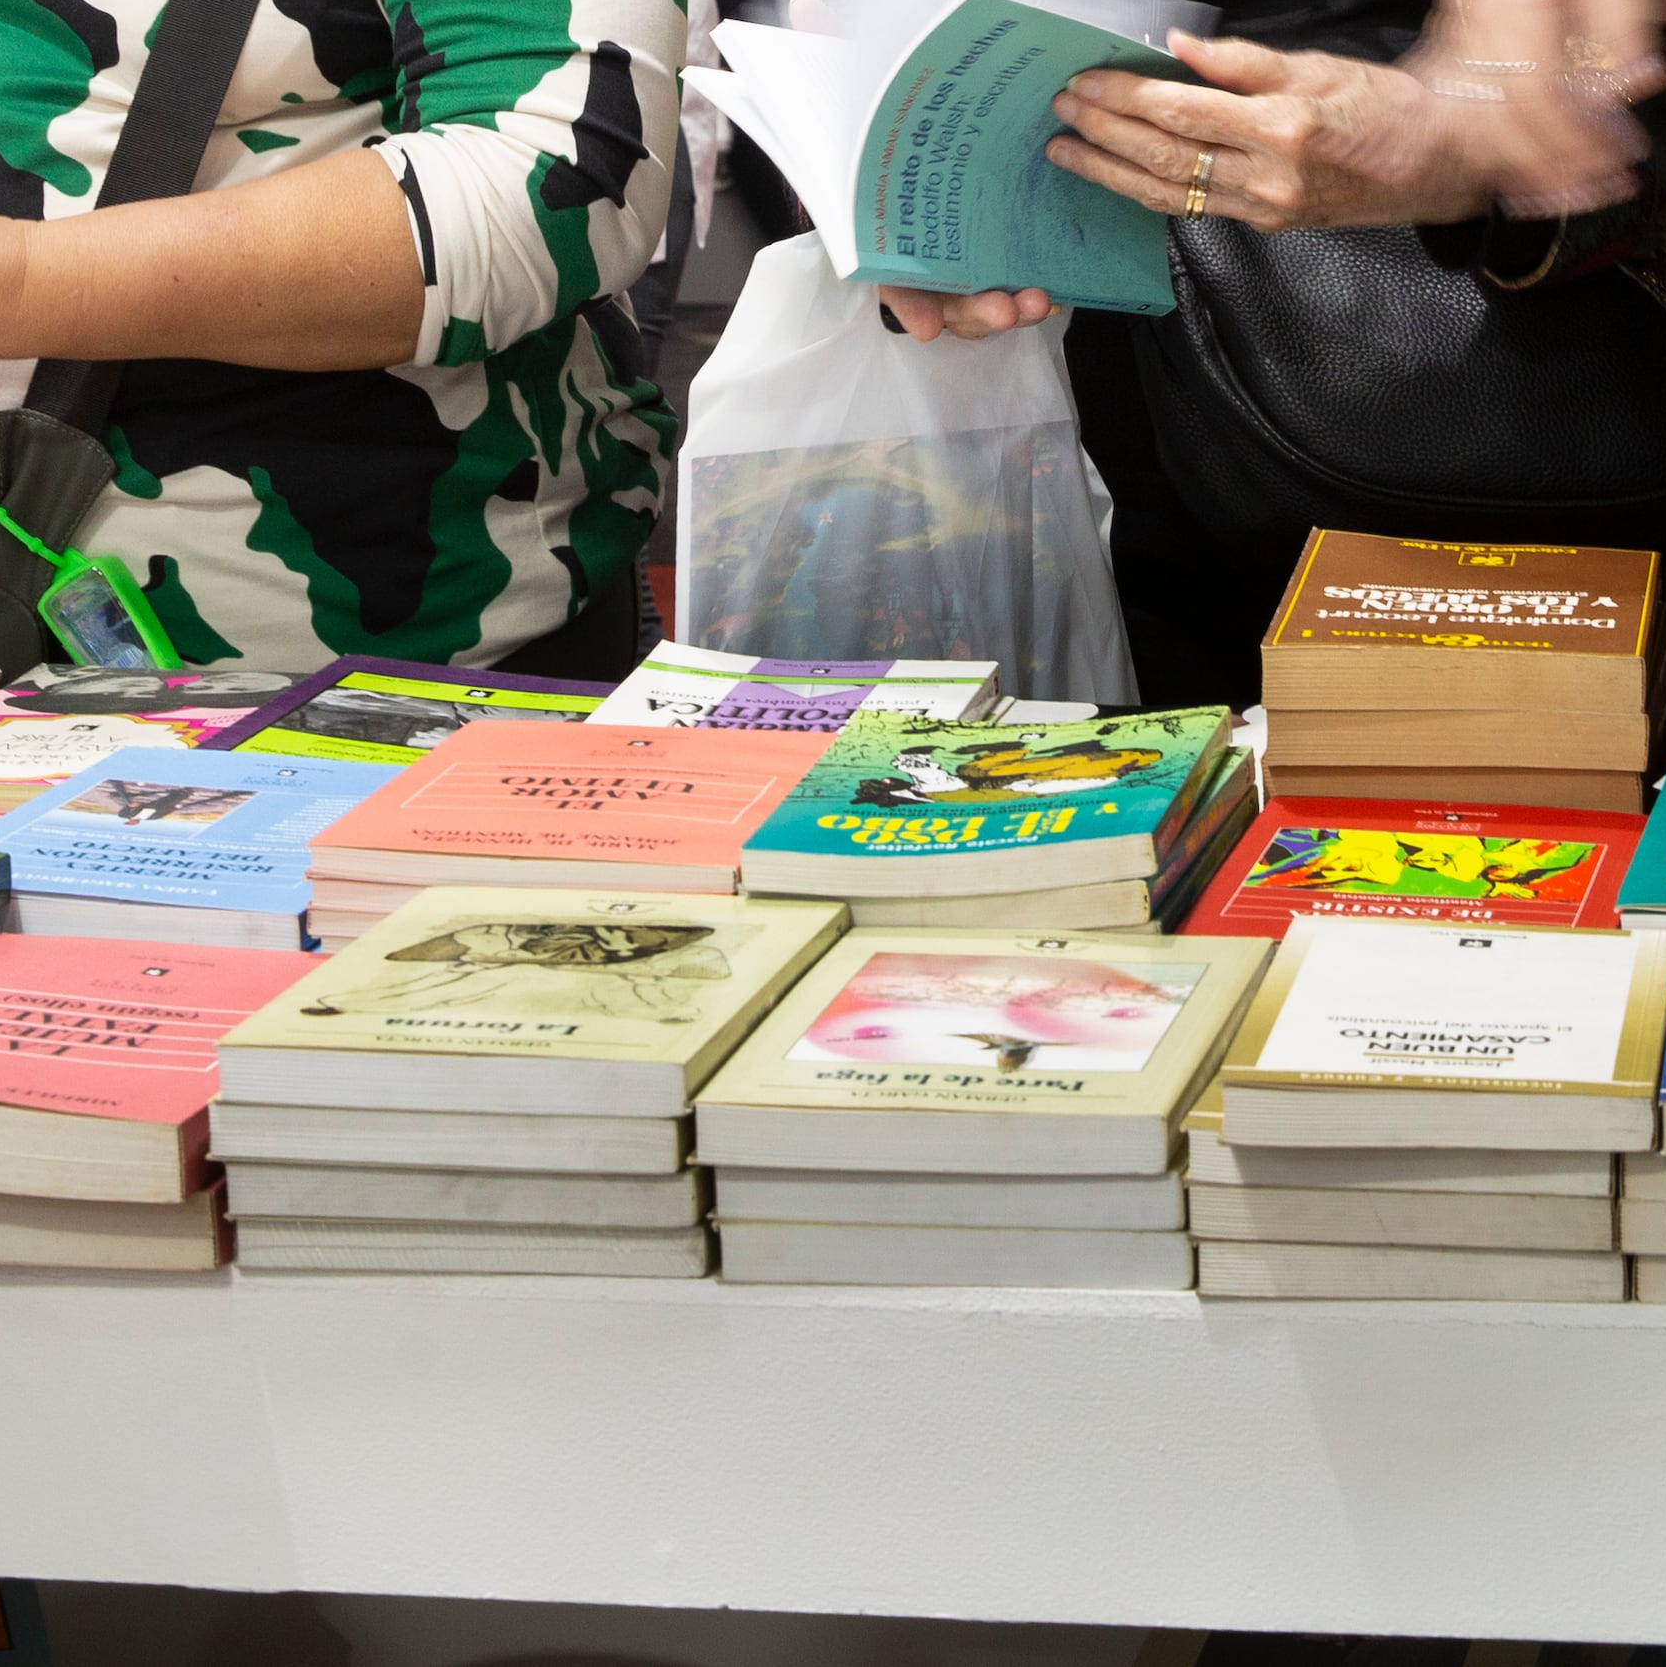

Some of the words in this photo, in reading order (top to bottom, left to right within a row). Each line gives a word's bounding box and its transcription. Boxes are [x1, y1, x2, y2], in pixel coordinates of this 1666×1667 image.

[945, 18, 1020, 77] hechos
[924, 81, 958, 112] los
[912, 118, 935, 148] de
[928, 94, 977, 166] Walsh:
[944, 142, 973, 262] testimonio
[965, 124, 982, 137] y
[974, 47, 1048, 119] escritura
[897, 155, 923, 226] relato
[921, 172, 944, 261] Rodolfo
[897, 234, 916, 258] El
[1324, 586, 1488, 604] JUEGOS
[1499, 595, 1580, 606] LOS
[1591, 596, 1619, 607] Y
[1361, 599, 1512, 614] ORDEN
[1315, 609, 1438, 624] Lecourt
[1448, 614, 1616, 628] Dominique
[509, 787, 664, 800] AMOR
[543, 799, 605, 810] EL
[816, 815, 986, 831] LOBO
[851, 830, 979, 843] OSO
[27, 848, 274, 873] RESURRECCIÓN
[88, 865, 217, 880] MUERTE
[1311, 901, 1440, 917] EXISTIR
[1451, 909, 1494, 918] DE
[1, 995, 85, 1014] ellos)
[96, 1004, 201, 1019] (según
[2, 1008, 161, 1034] FATAL
[384, 1018, 523, 1034] fortuna
[536, 1024, 580, 1036] La
[1339, 1029, 1551, 1044] CASAMIENTO
[7, 1040, 71, 1056] LA
[1366, 1042, 1456, 1053] BUEN
[1465, 1045, 1514, 1055] UN
[814, 1070, 890, 1086] fuga
[902, 1074, 932, 1086] la
[943, 1074, 984, 1087] de
[994, 1078, 1084, 1092] Parte
